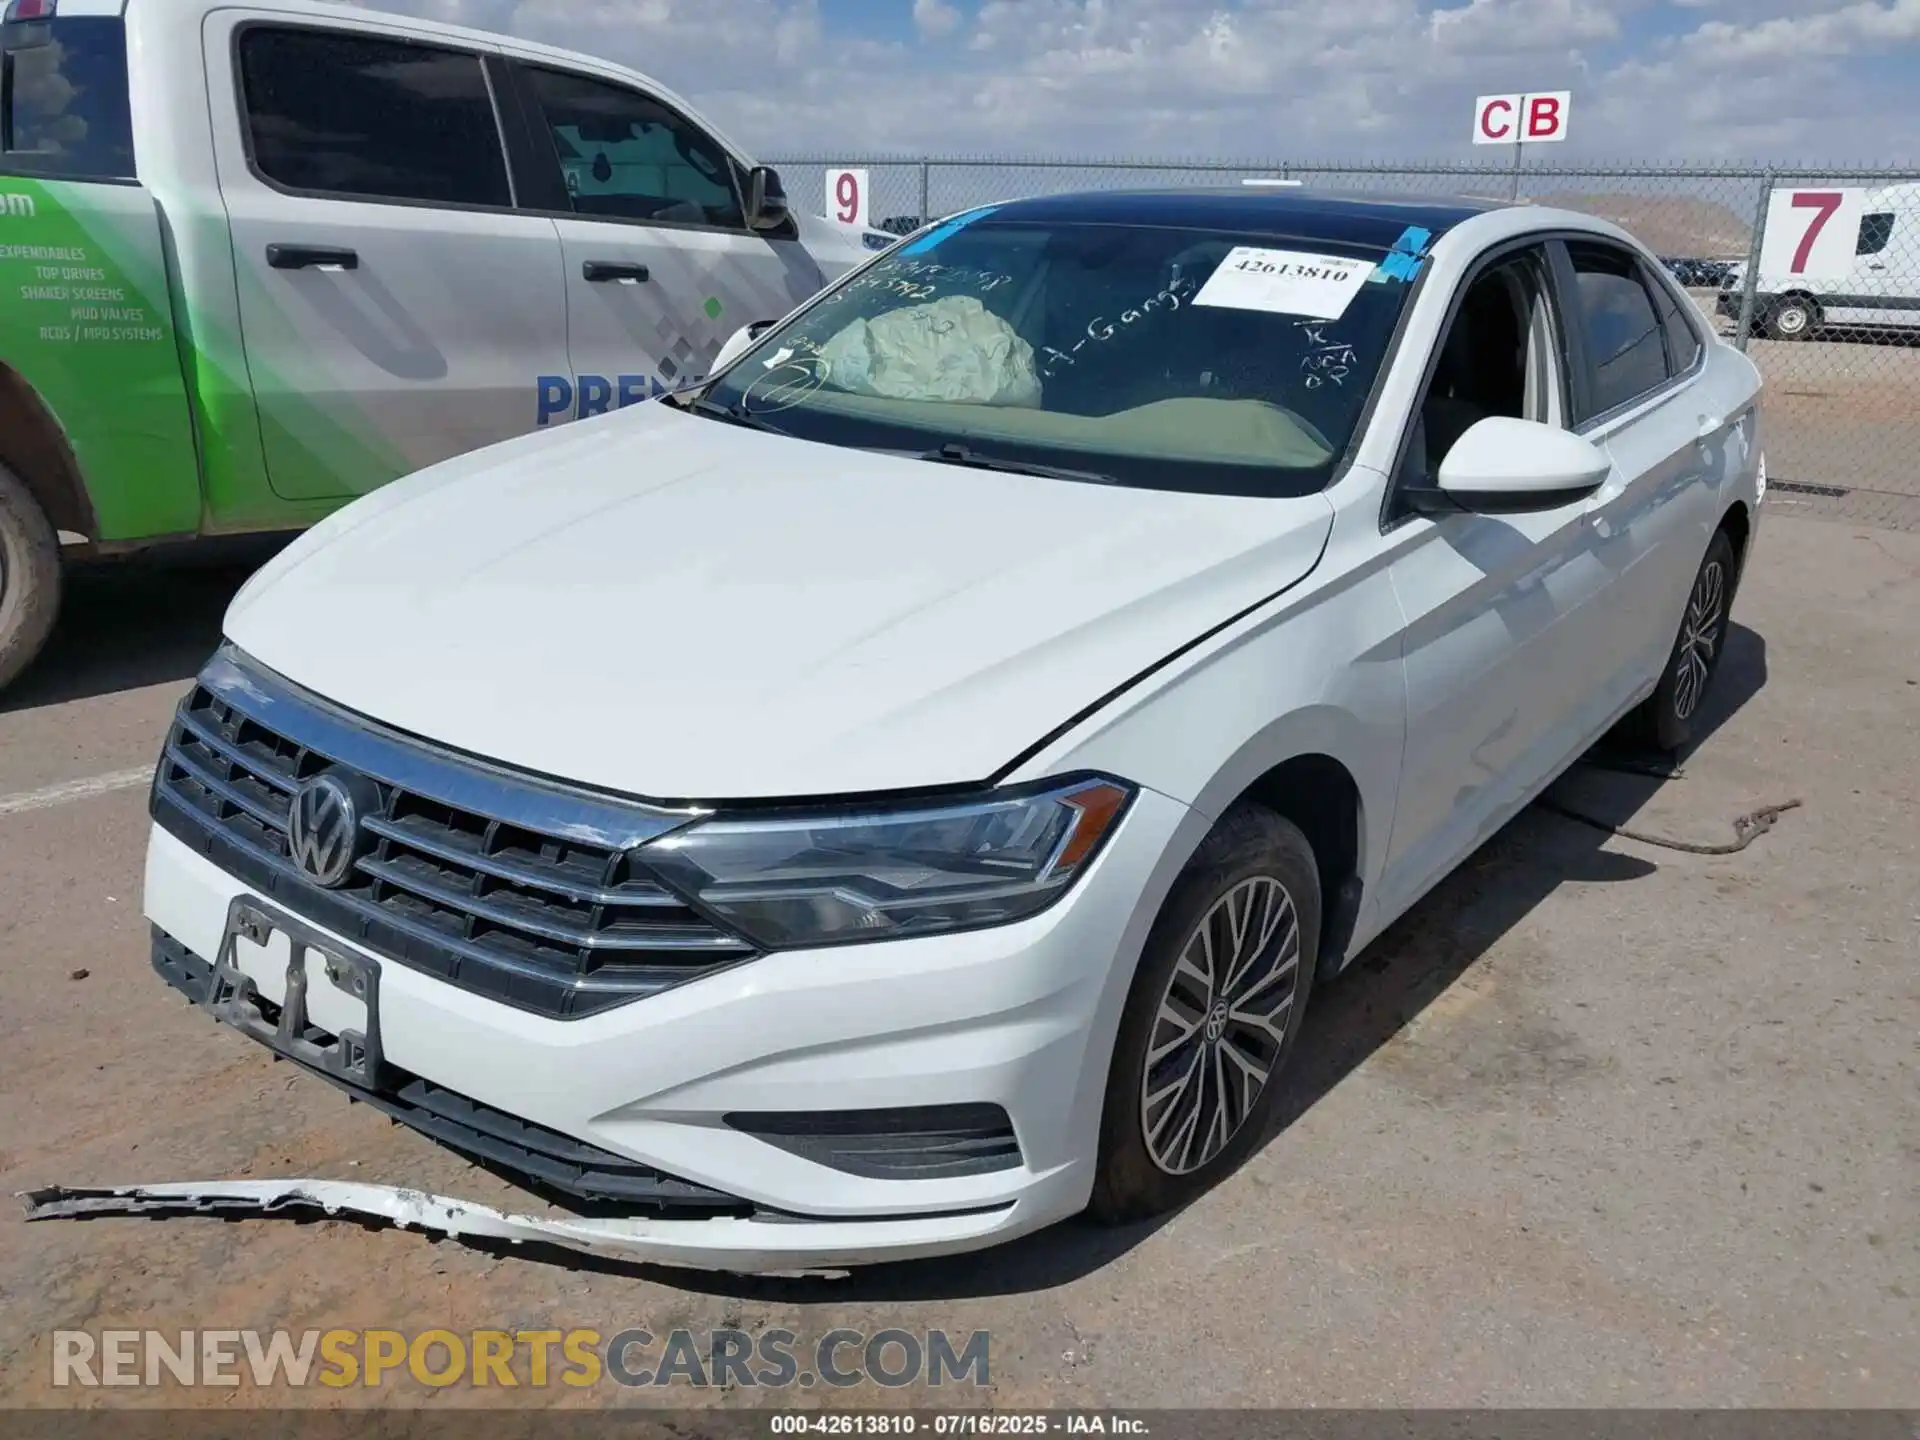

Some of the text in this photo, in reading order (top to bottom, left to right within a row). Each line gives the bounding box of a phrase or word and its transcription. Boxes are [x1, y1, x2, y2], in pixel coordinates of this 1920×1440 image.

[1480, 97, 1561, 139] C B
[836, 172, 859, 224] 9
[1789, 192, 1844, 274] 7
[0, 244, 86, 260] EXPENDABLES
[35, 265, 105, 281] TOP DRIVES
[1234, 259, 1350, 282] 42613810
[20, 285, 125, 301] SHAKER SCREENS
[70, 307, 144, 322] MUD VALVES
[112, 327, 163, 341] SYSTEMS
[537, 375, 703, 425] PRE
